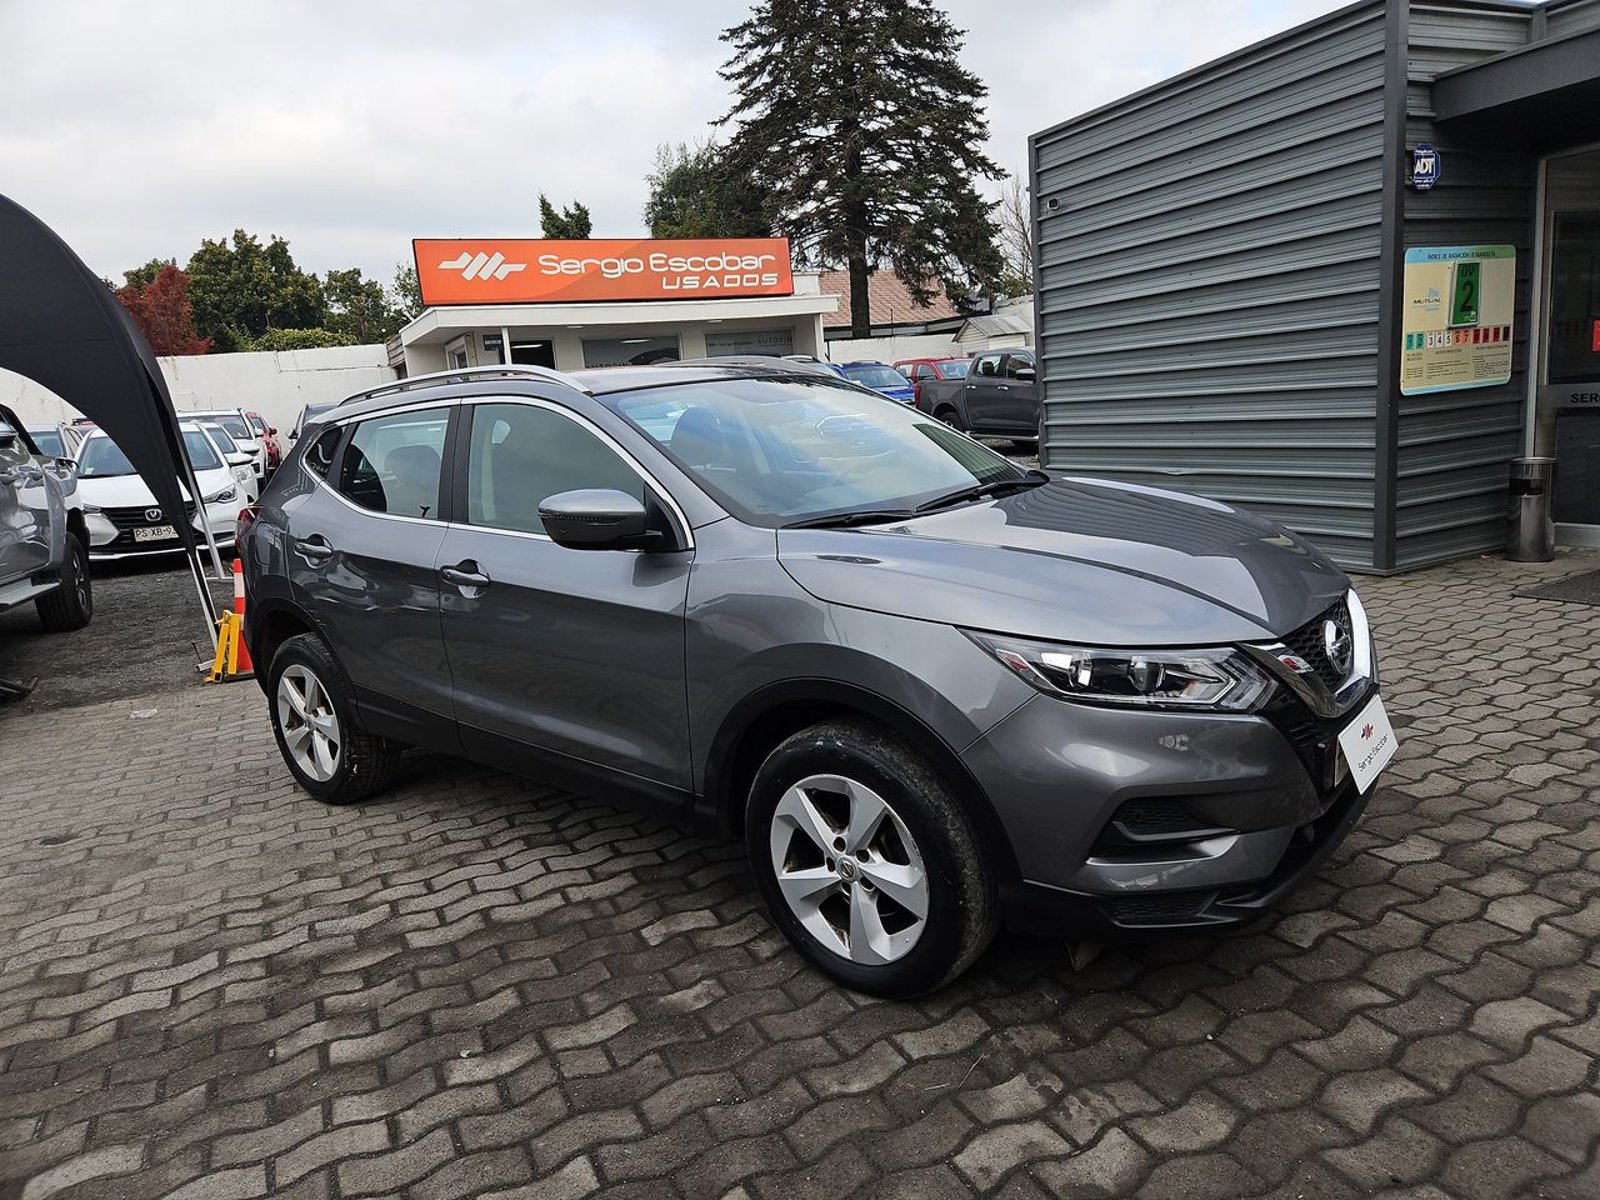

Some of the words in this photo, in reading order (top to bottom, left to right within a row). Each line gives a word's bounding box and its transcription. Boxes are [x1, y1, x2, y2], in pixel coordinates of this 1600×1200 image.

[1415, 158, 1435, 174] ADT
[538, 253, 644, 279] Sergio
[649, 251, 776, 273] Escobar
[662, 273, 779, 290] USADOS
[1460, 280, 1474, 312] 2
[1570, 393, 1600, 404] SER
[136, 530, 148, 538] PS
